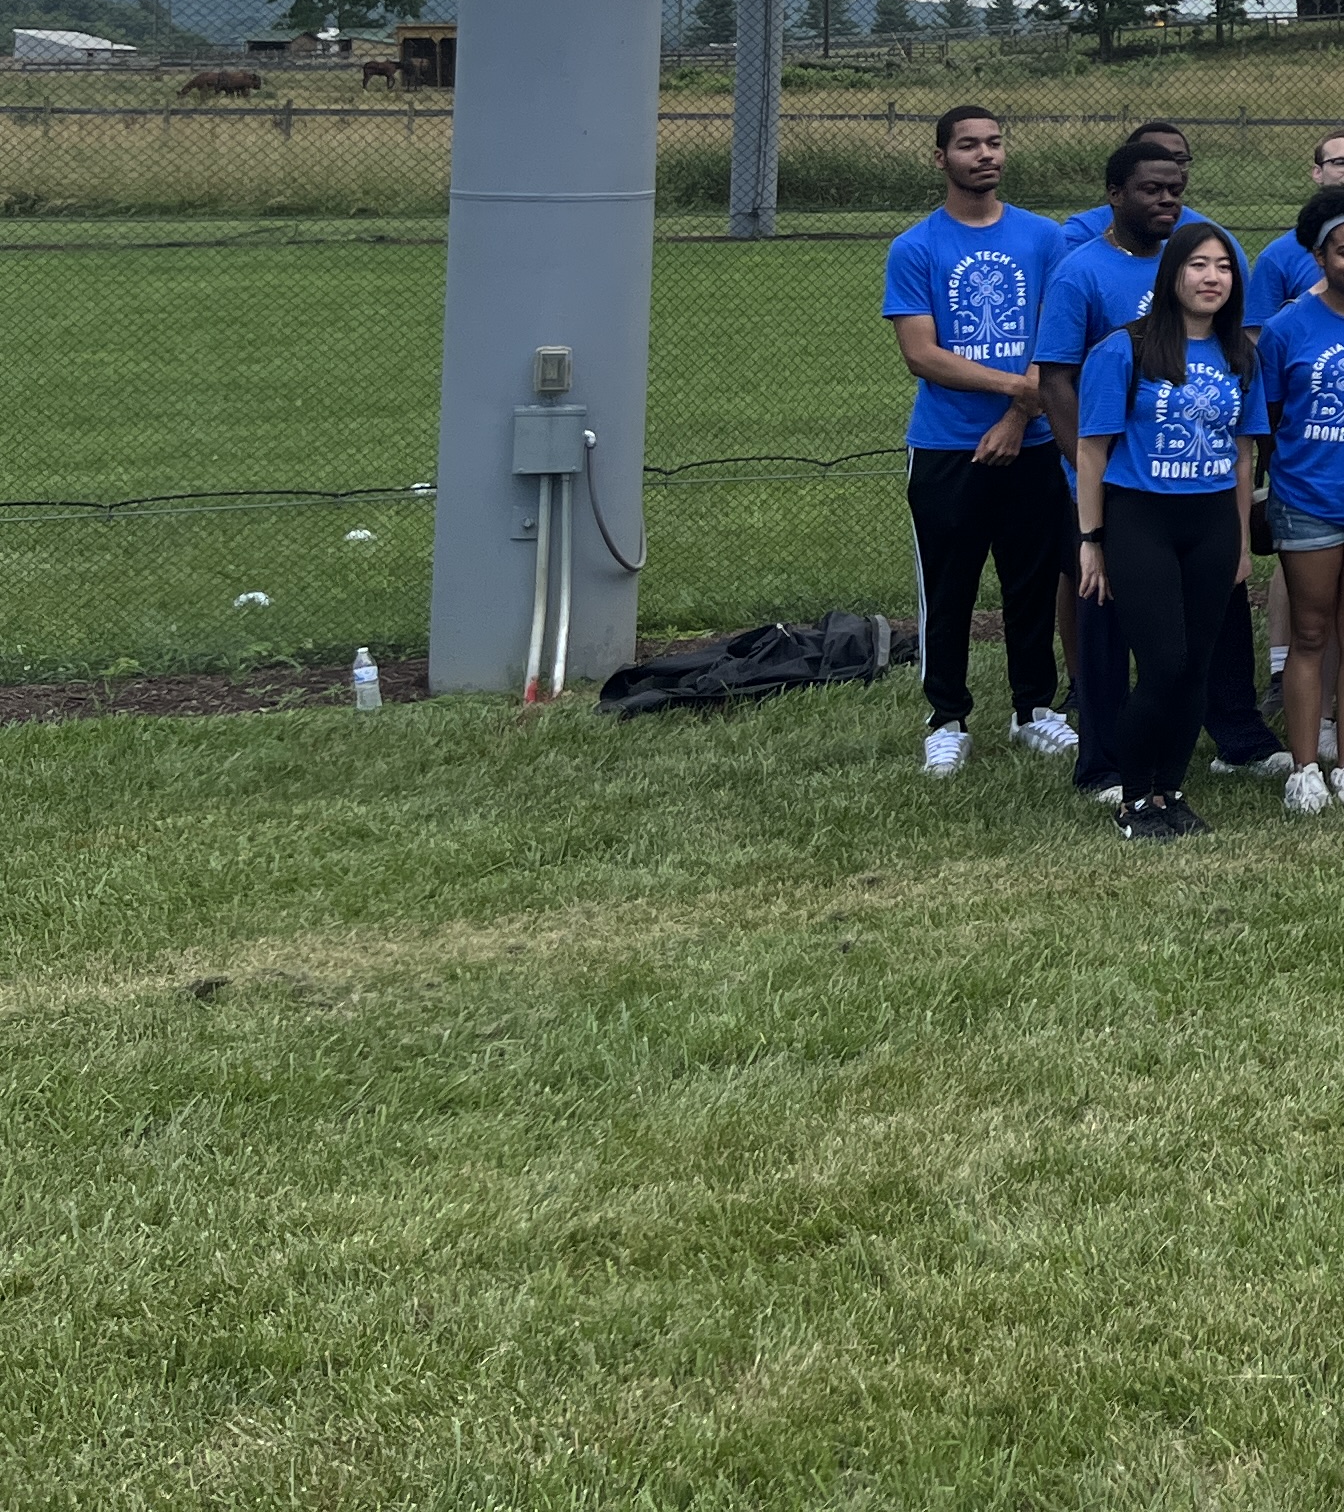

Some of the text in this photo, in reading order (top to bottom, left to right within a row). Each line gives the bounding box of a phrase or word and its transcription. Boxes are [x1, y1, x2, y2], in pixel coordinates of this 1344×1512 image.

[949, 251, 1026, 311] VIRGINIA TECH WING
[1155, 363, 1242, 426] VIRGI TECH WING
[1321, 406, 1336, 415] 20
[1168, 439, 1185, 448] 20
[1151, 460, 1199, 478] DRONE
